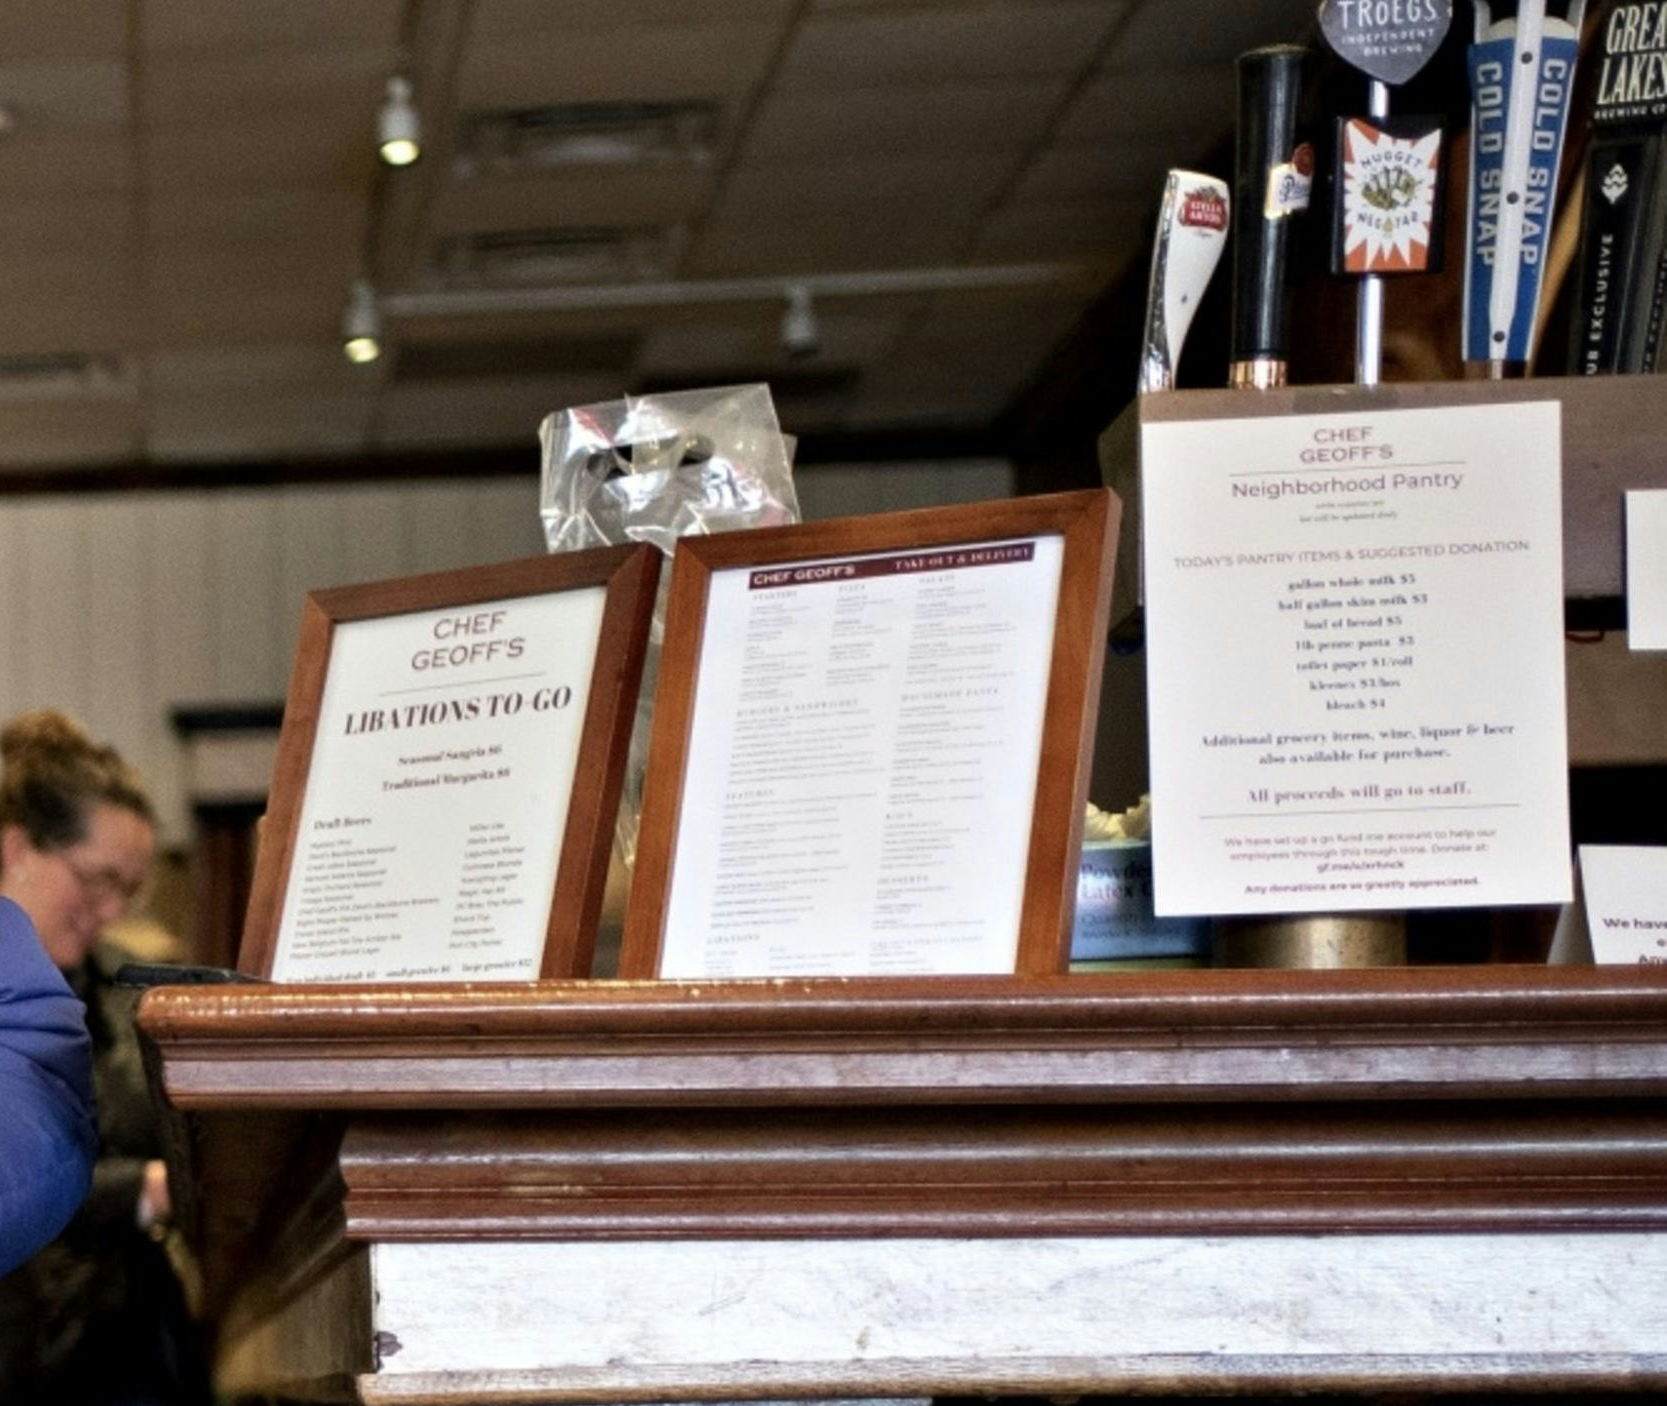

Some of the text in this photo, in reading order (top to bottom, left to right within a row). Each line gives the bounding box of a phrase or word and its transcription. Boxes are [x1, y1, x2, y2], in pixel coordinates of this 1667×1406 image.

[1341, 29, 1434, 44] INDEPENDENT
[1606, 2, 1667, 54] GREA
[1364, 45, 1422, 57] BREWING
[1361, 151, 1422, 168] NUGGET
[1476, 61, 1503, 265] COLD SNAP
[1520, 58, 1566, 265] COLD SNAP
[1357, 211, 1418, 229] NECTAR
[1586, 234, 1613, 375] UB EXCLUSIVE
[1313, 426, 1373, 443] CHEF
[1299, 445, 1393, 463] GEOFF'S
[1231, 472, 1464, 501] Neighborhood Pantry
[1174, 539, 1530, 569] TODAY'S PANTRY ITEMS & SUGGESTED DONATION
[753, 570, 789, 586] CHEF
[1288, 578, 1325, 592] gallon
[1329, 576, 1364, 587] whole
[1278, 600, 1303, 611] half
[1306, 598, 1343, 611] gallon
[1346, 596, 1376, 608] skim
[434, 611, 507, 640] CHEF
[1346, 616, 1383, 628] bread
[411, 637, 525, 671] GEOFF'S
[1326, 699, 1365, 711] bleach
[344, 697, 481, 735] LIBATIONS
[1202, 733, 1272, 748] Additional
[1276, 732, 1327, 748] grocery
[1420, 726, 1461, 741] liquor
[1483, 722, 1515, 736] beer
[397, 750, 445, 766] Seasonal
[446, 747, 486, 763] Sangria
[1290, 751, 1354, 765] available
[1358, 749, 1378, 761] for
[382, 775, 440, 793] Traditional
[443, 771, 495, 787] Margarita
[1248, 789, 1268, 804] All
[1274, 787, 1345, 805] proceeds
[1351, 785, 1379, 799] will
[1384, 786, 1403, 799] go
[1408, 784, 1423, 796] to
[314, 817, 373, 831] Draft Beers
[1336, 832, 1363, 843] fund
[1433, 829, 1447, 840] to
[1448, 828, 1474, 842] help
[1430, 842, 1472, 854] Donate
[1244, 884, 1267, 895] Any
[1269, 881, 1327, 893] donations
[1365, 879, 1406, 892] greatly
[1603, 918, 1630, 929] We
